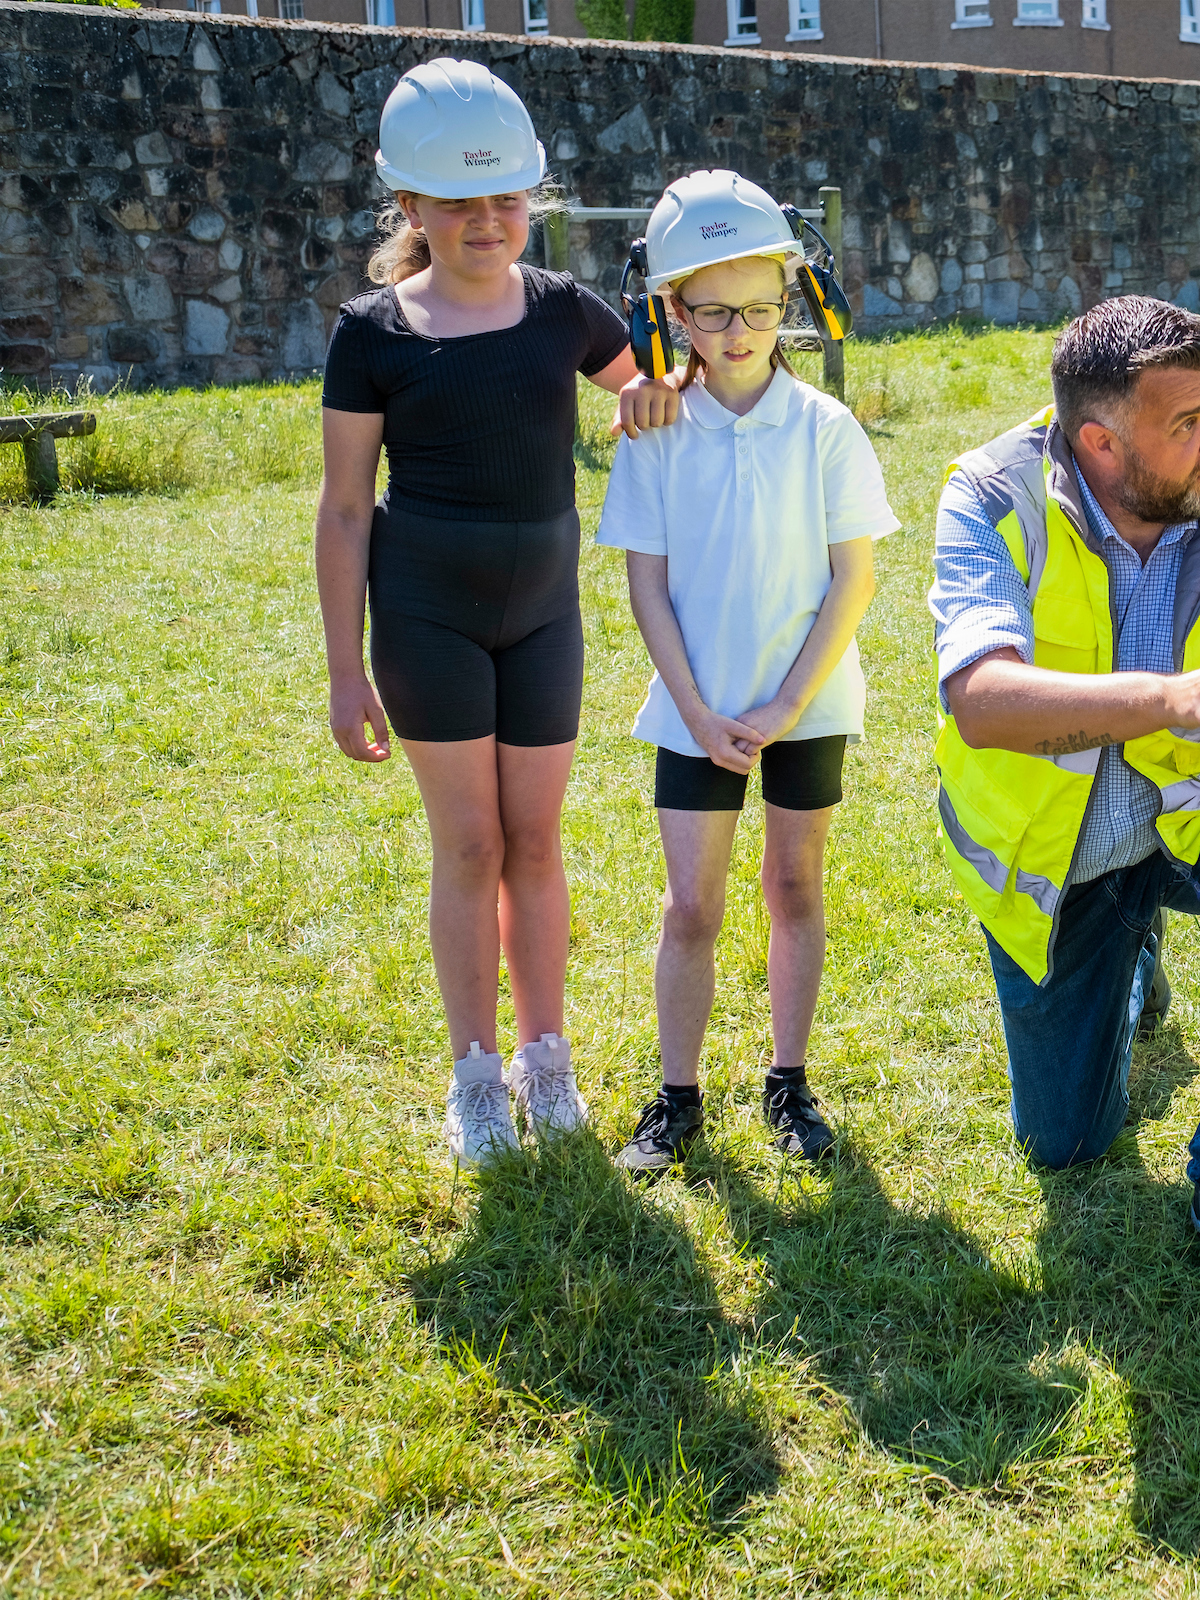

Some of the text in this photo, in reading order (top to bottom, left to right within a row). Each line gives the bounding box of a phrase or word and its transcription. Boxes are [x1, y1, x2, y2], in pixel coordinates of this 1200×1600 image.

[462, 149, 492, 160] Taylor
[464, 156, 501, 167] Wimpey
[699, 221, 728, 233] Taylor
[701, 227, 738, 240] Wimpey
